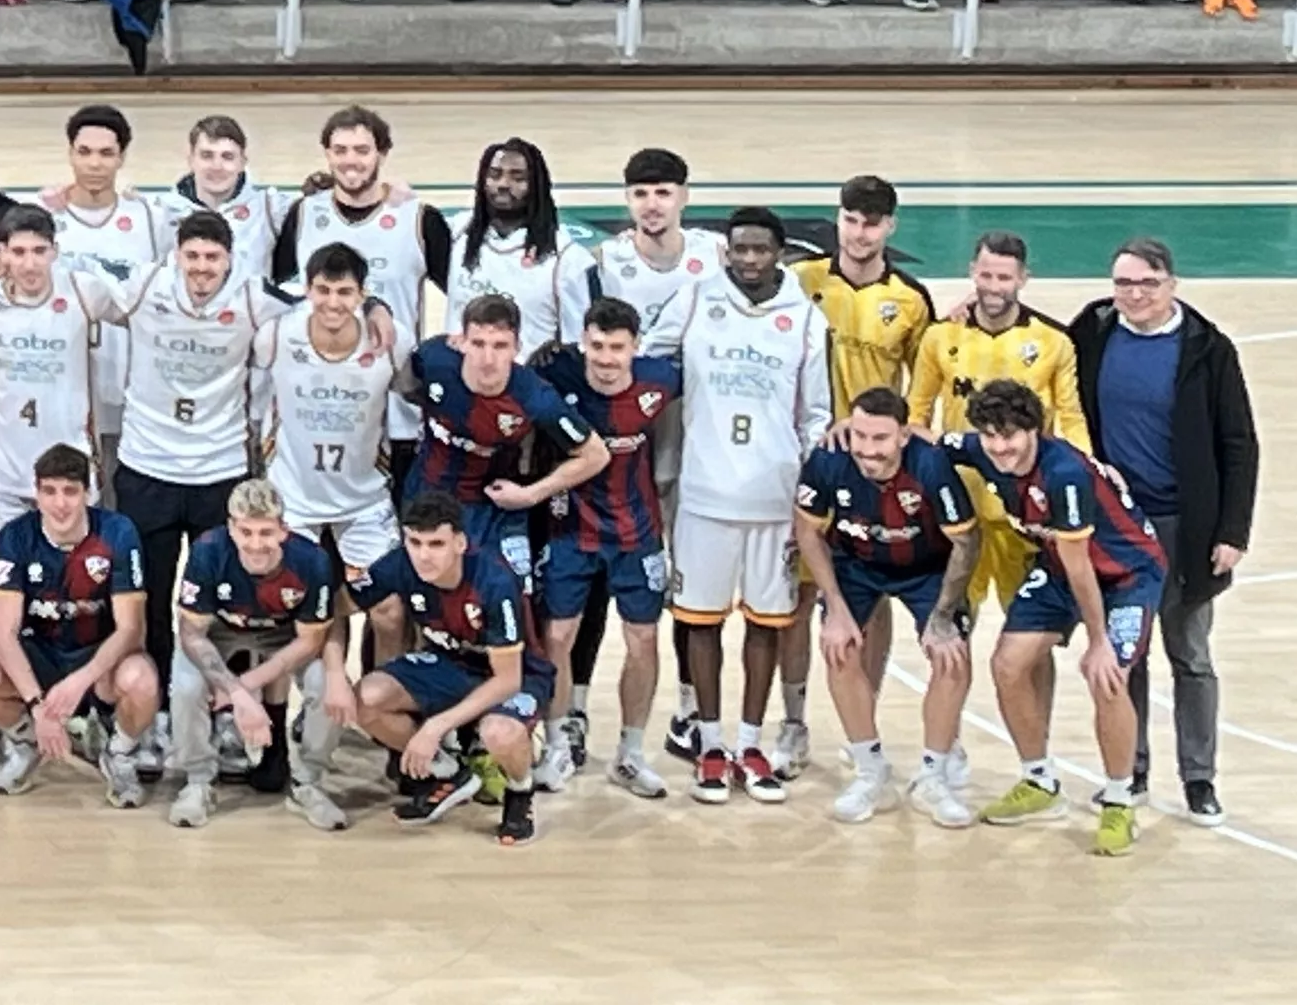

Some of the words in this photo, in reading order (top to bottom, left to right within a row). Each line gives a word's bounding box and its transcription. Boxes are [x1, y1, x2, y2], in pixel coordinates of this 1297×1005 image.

[19, 398, 38, 428] 4
[175, 398, 195, 425] 6
[731, 414, 751, 446] 8
[313, 443, 346, 473] 17
[1017, 568, 1049, 598] 2
